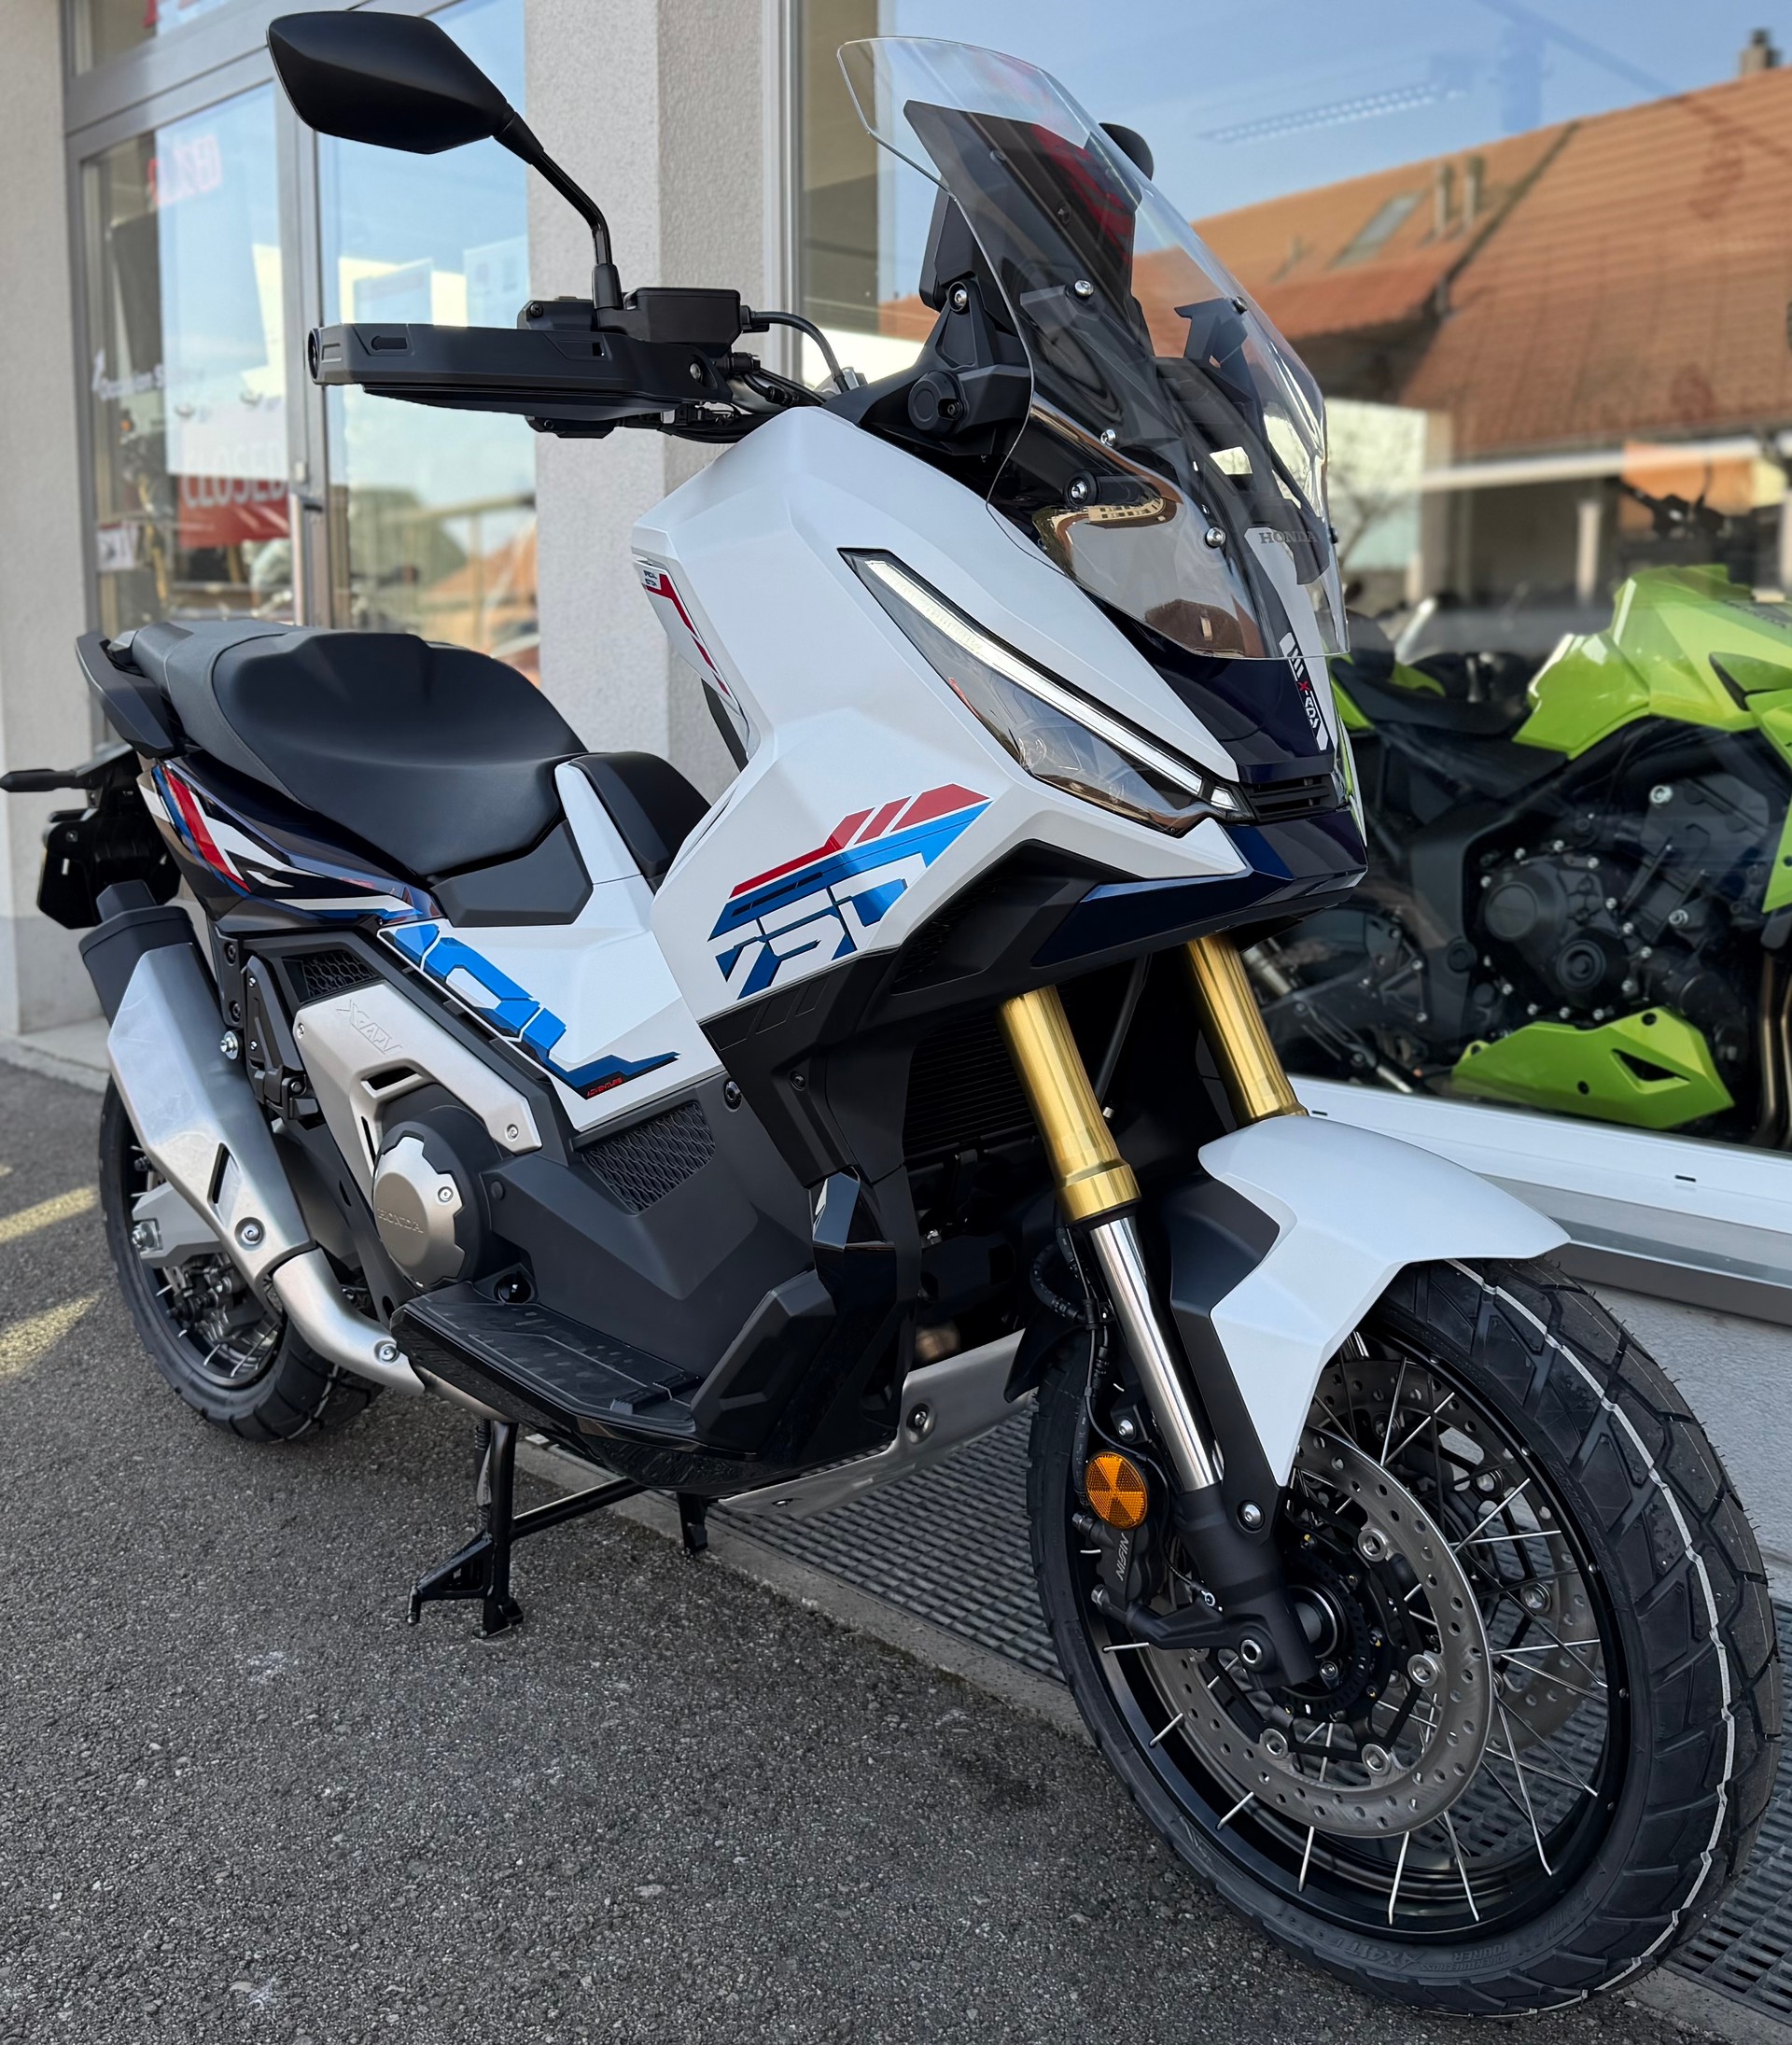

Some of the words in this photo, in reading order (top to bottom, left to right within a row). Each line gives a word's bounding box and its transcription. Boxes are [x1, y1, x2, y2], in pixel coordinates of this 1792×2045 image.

[1259, 530, 1320, 544] HONDA
[1298, 680, 1319, 728] X-ADV
[708, 851, 928, 1000] 750
[377, 1208, 424, 1234] HONDA
[1115, 1532, 1129, 1581] NISSIN
[1454, 1941, 1509, 1962] TOURER
